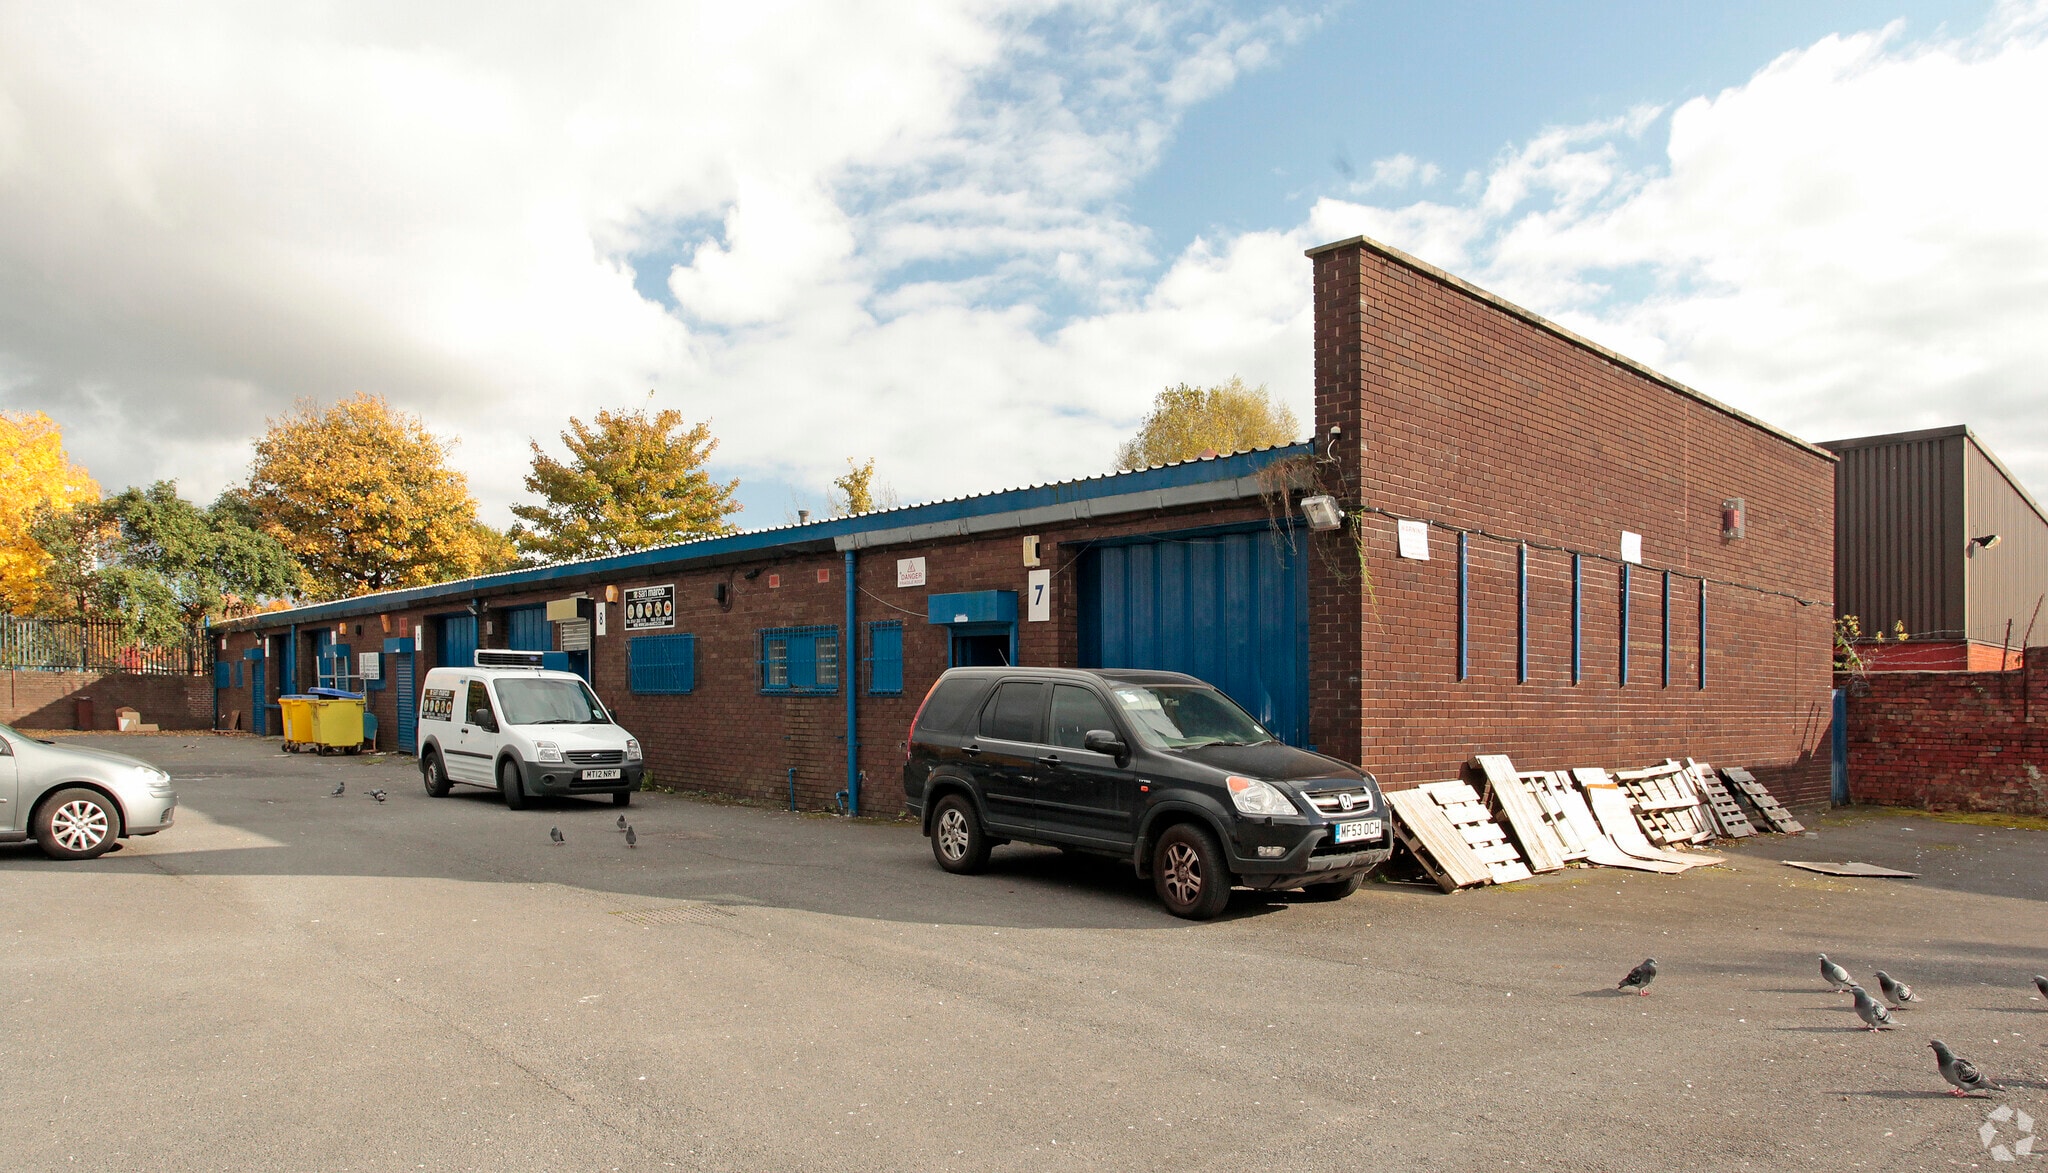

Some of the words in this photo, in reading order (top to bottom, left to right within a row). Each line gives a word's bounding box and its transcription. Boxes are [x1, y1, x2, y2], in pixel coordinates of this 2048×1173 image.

[901, 572, 922, 580] DANGER
[648, 587, 665, 597] marco
[1035, 584, 1044, 605] 7
[586, 770, 602, 778] MT12
[1341, 823, 1362, 838] MF53
[1364, 821, 1380, 835] OCH
